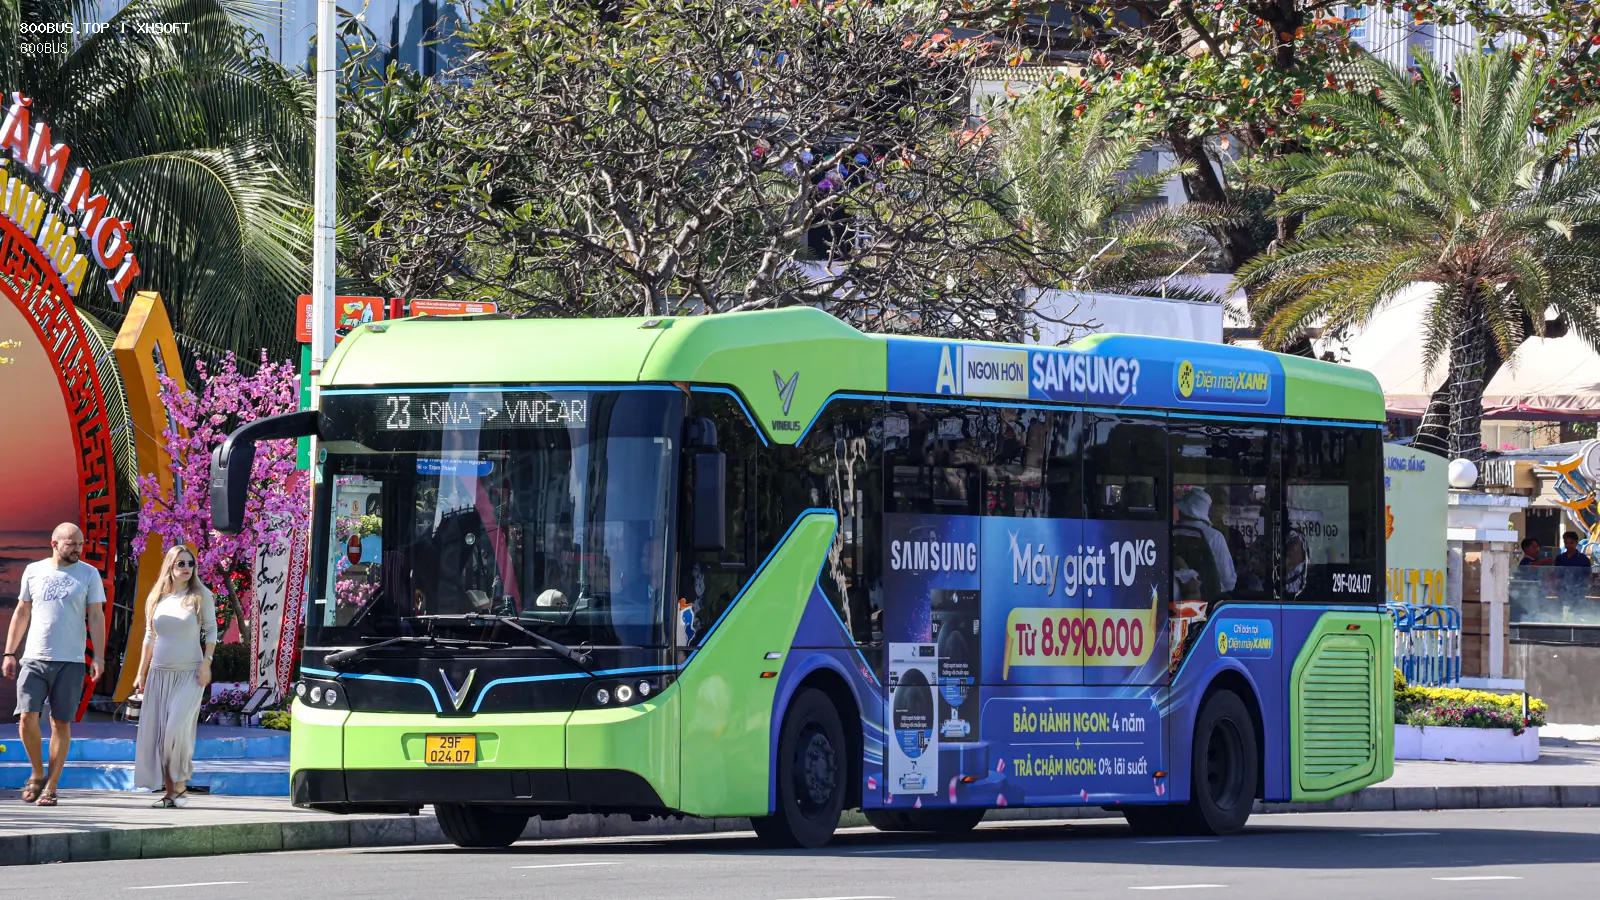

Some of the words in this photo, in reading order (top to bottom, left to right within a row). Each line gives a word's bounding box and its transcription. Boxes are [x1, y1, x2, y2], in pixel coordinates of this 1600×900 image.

[0, 91, 71, 194] ĂM
[61, 167, 141, 303] MỚI
[935, 345, 963, 394] AI
[968, 361, 999, 381] NGON
[1001, 361, 1024, 382] HƠN
[1031, 352, 1140, 395] SAMSUNG?
[1195, 370, 1217, 393] Điện
[386, 396, 411, 429] 23
[771, 420, 801, 431] VINBUS
[891, 540, 977, 571] SAMSUNG
[1013, 543, 1060, 596] Máy
[1063, 545, 1106, 598] giặt
[1332, 573, 1372, 593] 29F-024.07
[1015, 623, 1037, 656] Từ
[1041, 617, 1144, 657] 8.990.000
[1013, 706, 1038, 733] BẢO
[1040, 707, 1071, 733] HÀNH
[1073, 712, 1110, 732] NGON:
[1112, 712, 1119, 732] 4
[1121, 713, 1145, 732] năm
[430, 750, 470, 762] 024.07
[440, 736, 461, 748] 29F
[1013, 753, 1033, 777] TRẢ
[1034, 754, 1063, 781] CHẬM
[1065, 758, 1097, 776] NGON:
[1098, 758, 1112, 775] 0%
[1114, 757, 1125, 775] lãi
[1127, 756, 1147, 775] suất
